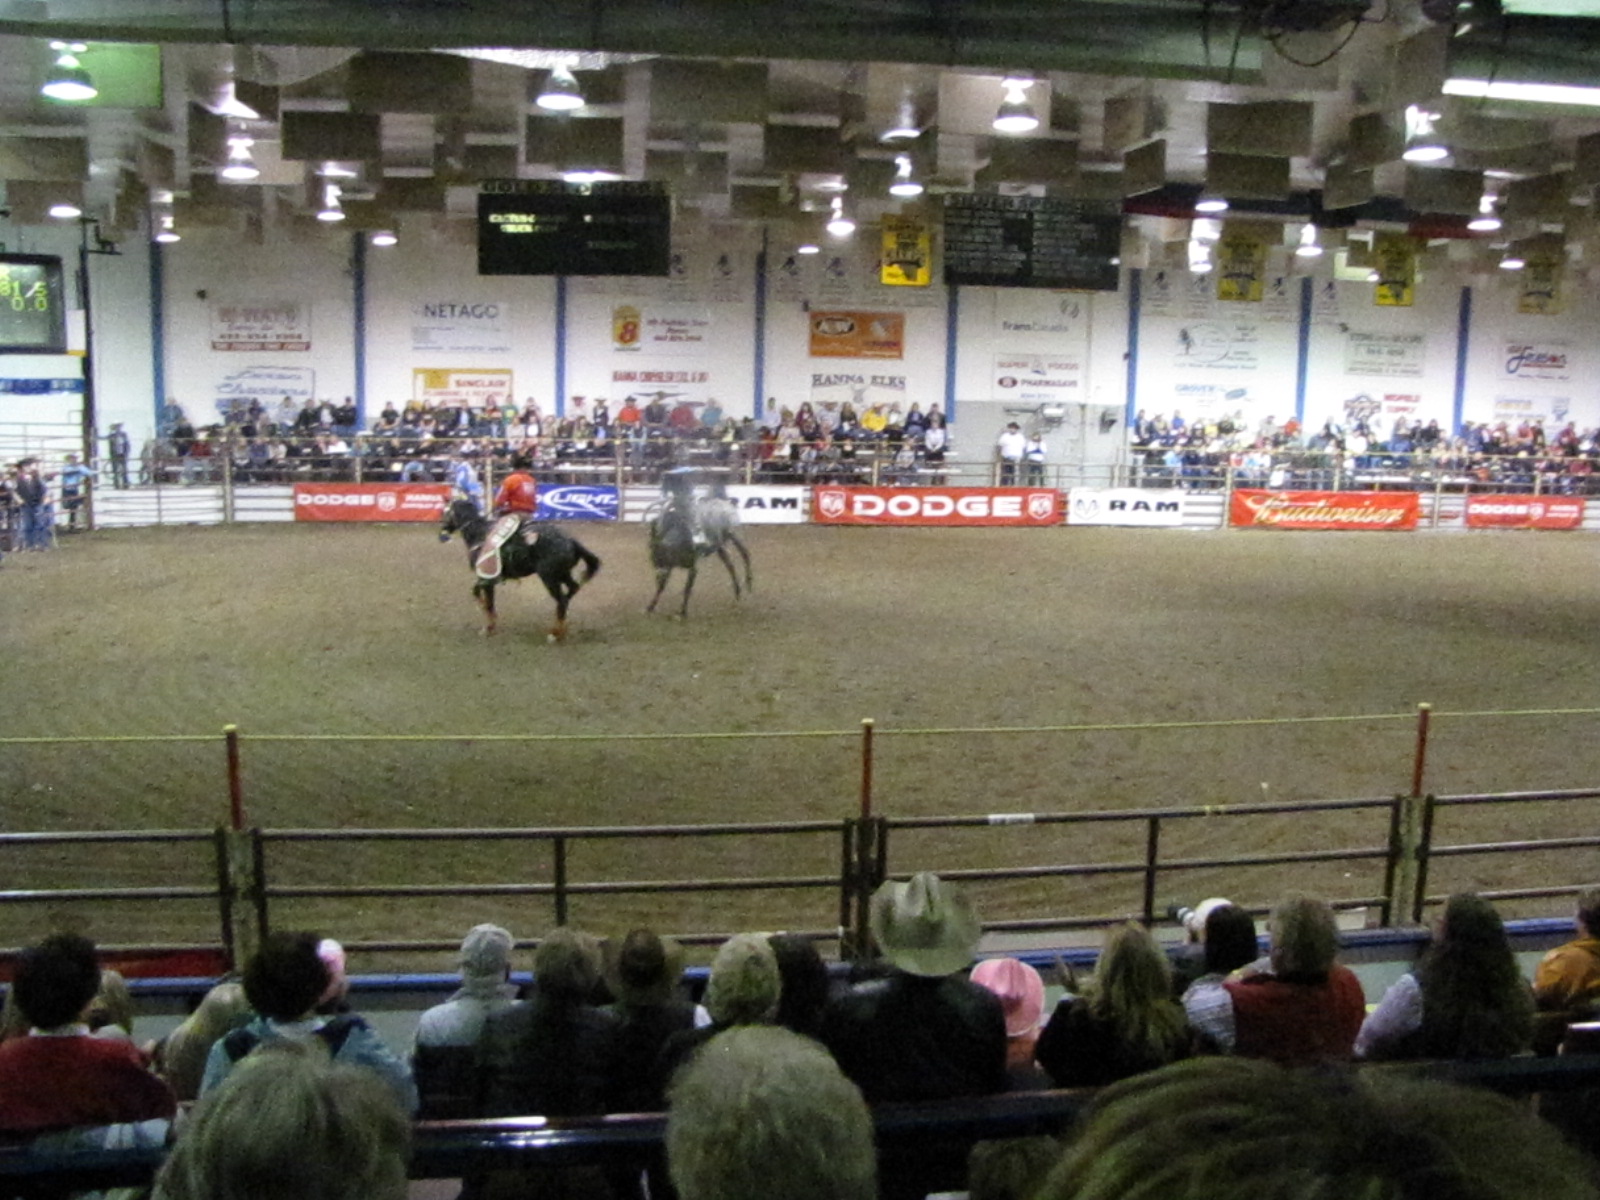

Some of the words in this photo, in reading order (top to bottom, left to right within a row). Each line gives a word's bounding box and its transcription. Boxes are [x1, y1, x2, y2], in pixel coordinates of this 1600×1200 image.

[424, 303, 499, 319] NETAGO
[812, 374, 864, 387] HANNA
[870, 376, 906, 391] ELKS
[297, 494, 375, 505] DODGE
[853, 495, 1022, 517] DODGE
[1109, 500, 1179, 512] RAM
[1245, 493, 1405, 524] Budweiser
[1468, 504, 1527, 514] DODGE
